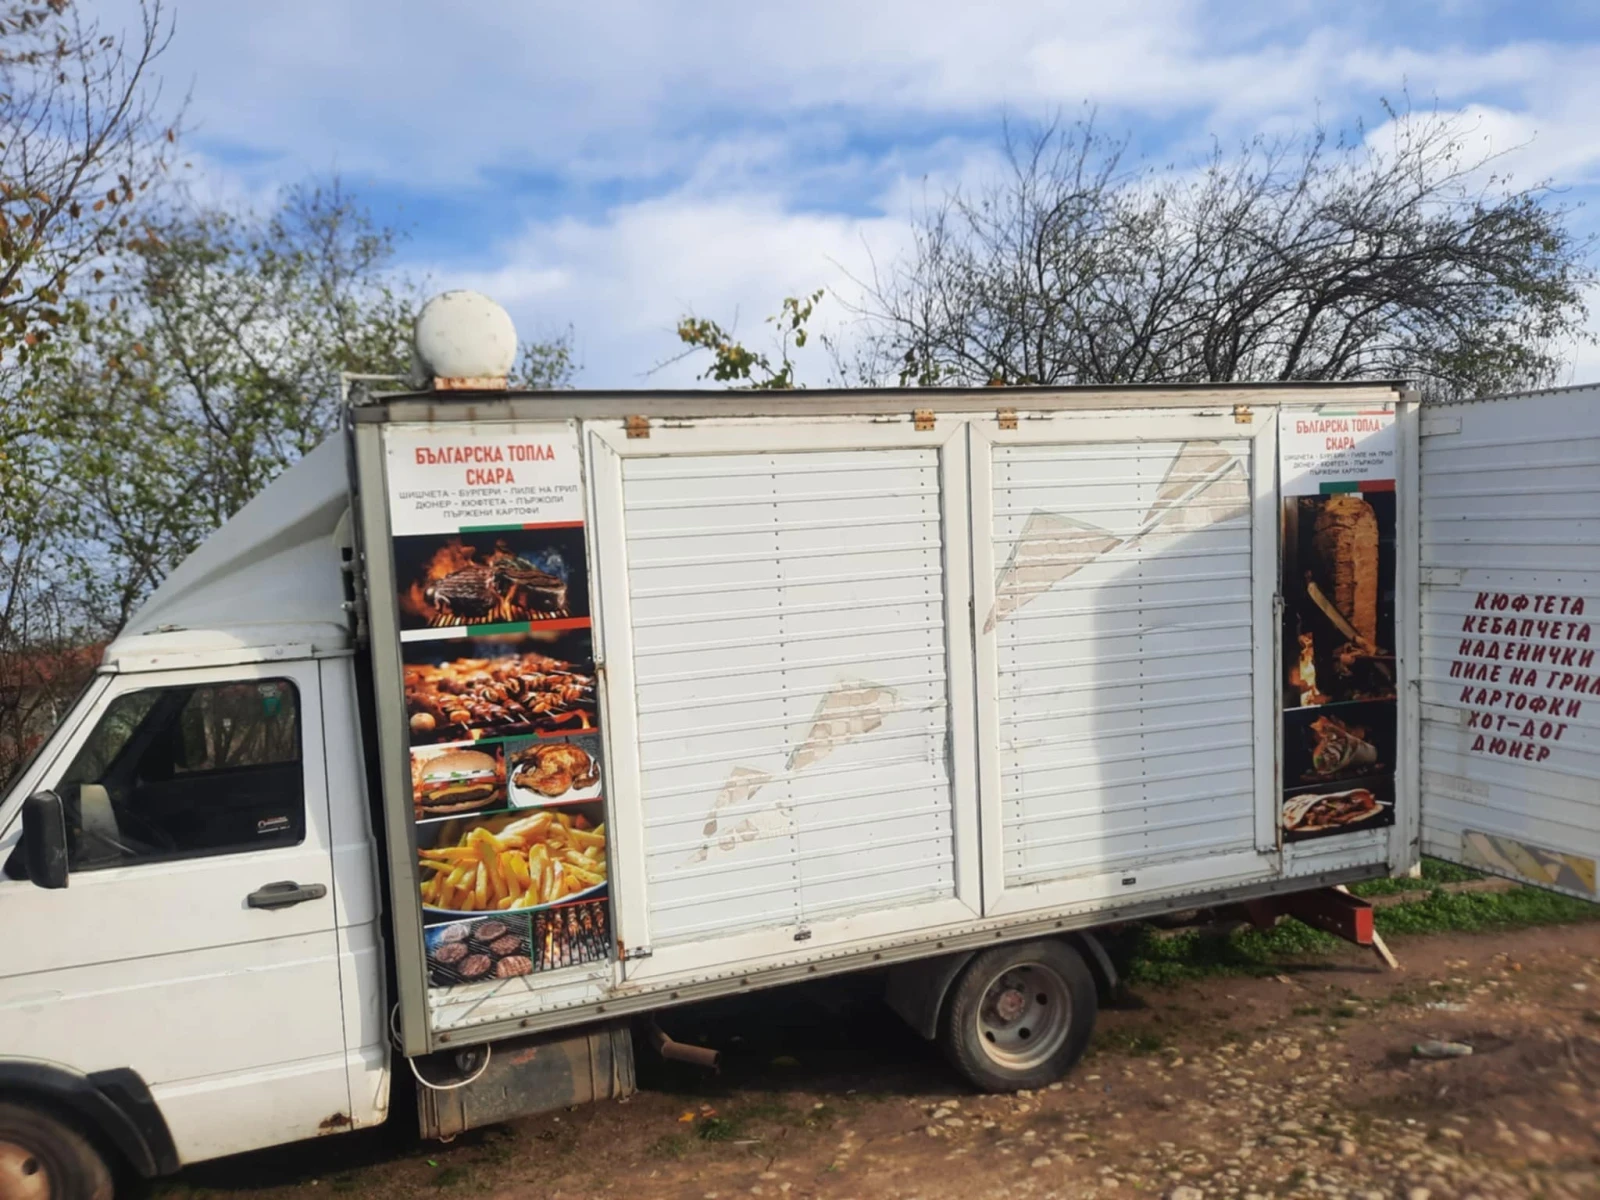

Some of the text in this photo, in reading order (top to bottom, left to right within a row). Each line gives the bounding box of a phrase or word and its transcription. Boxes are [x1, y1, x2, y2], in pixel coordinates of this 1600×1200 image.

[1296, 419, 1380, 433] БЪЛГАРСКА ТОПЛА
[415, 444, 555, 465] БЪЛГАРСКА ТОПЛА
[1326, 437, 1355, 451] СКАРА
[466, 468, 515, 485] СКАРА
[459, 488, 501, 497] БУРГЕРИ
[510, 487, 535, 495] ПИЛЕ
[539, 486, 551, 494] НА
[555, 485, 578, 493] ГРИЛ
[415, 500, 451, 510] ДЮНЕР
[461, 498, 507, 507] КЮФТЕТА
[516, 496, 564, 505] ПЪРЖОЛИ
[443, 508, 539, 518] ПЪРЖЕНИ КАРТОФИ
[1475, 592, 1585, 616] КЮФТЕТА
[1462, 615, 1591, 642] КЕБАПЧЕТА
[1459, 639, 1595, 668] НАДЕНИЧКИ
[1449, 661, 1600, 695] ПИЛЕ НА ГРИЛ
[1460, 686, 1582, 718] КАРТОФКИ
[1467, 710, 1568, 741] ХОТ-ДОГ
[1471, 734, 1550, 762] ДЮНЕР
